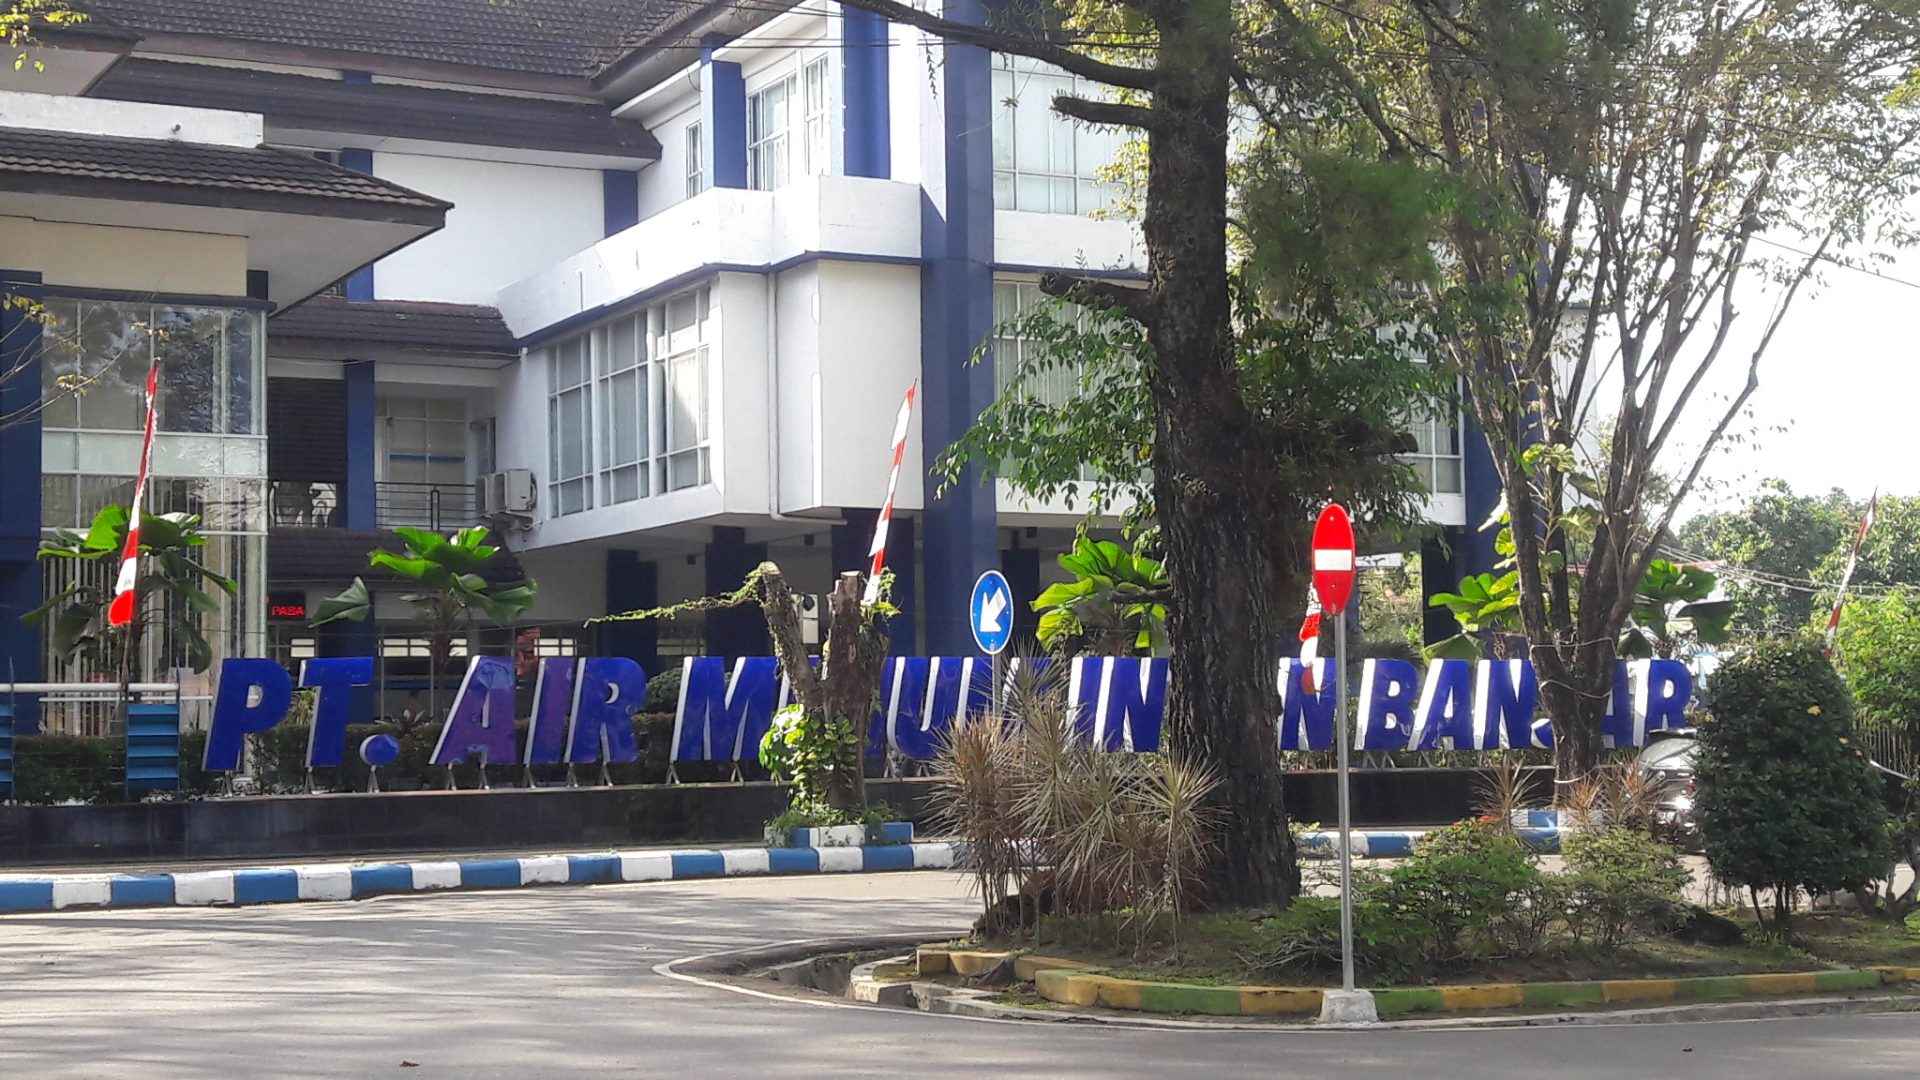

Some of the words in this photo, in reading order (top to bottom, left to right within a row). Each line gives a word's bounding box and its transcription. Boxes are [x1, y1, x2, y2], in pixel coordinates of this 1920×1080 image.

[201, 656, 401, 772] PT.
[428, 654, 648, 766] AIR
[669, 655, 1054, 764] MUM
[1062, 655, 1338, 752] INN
